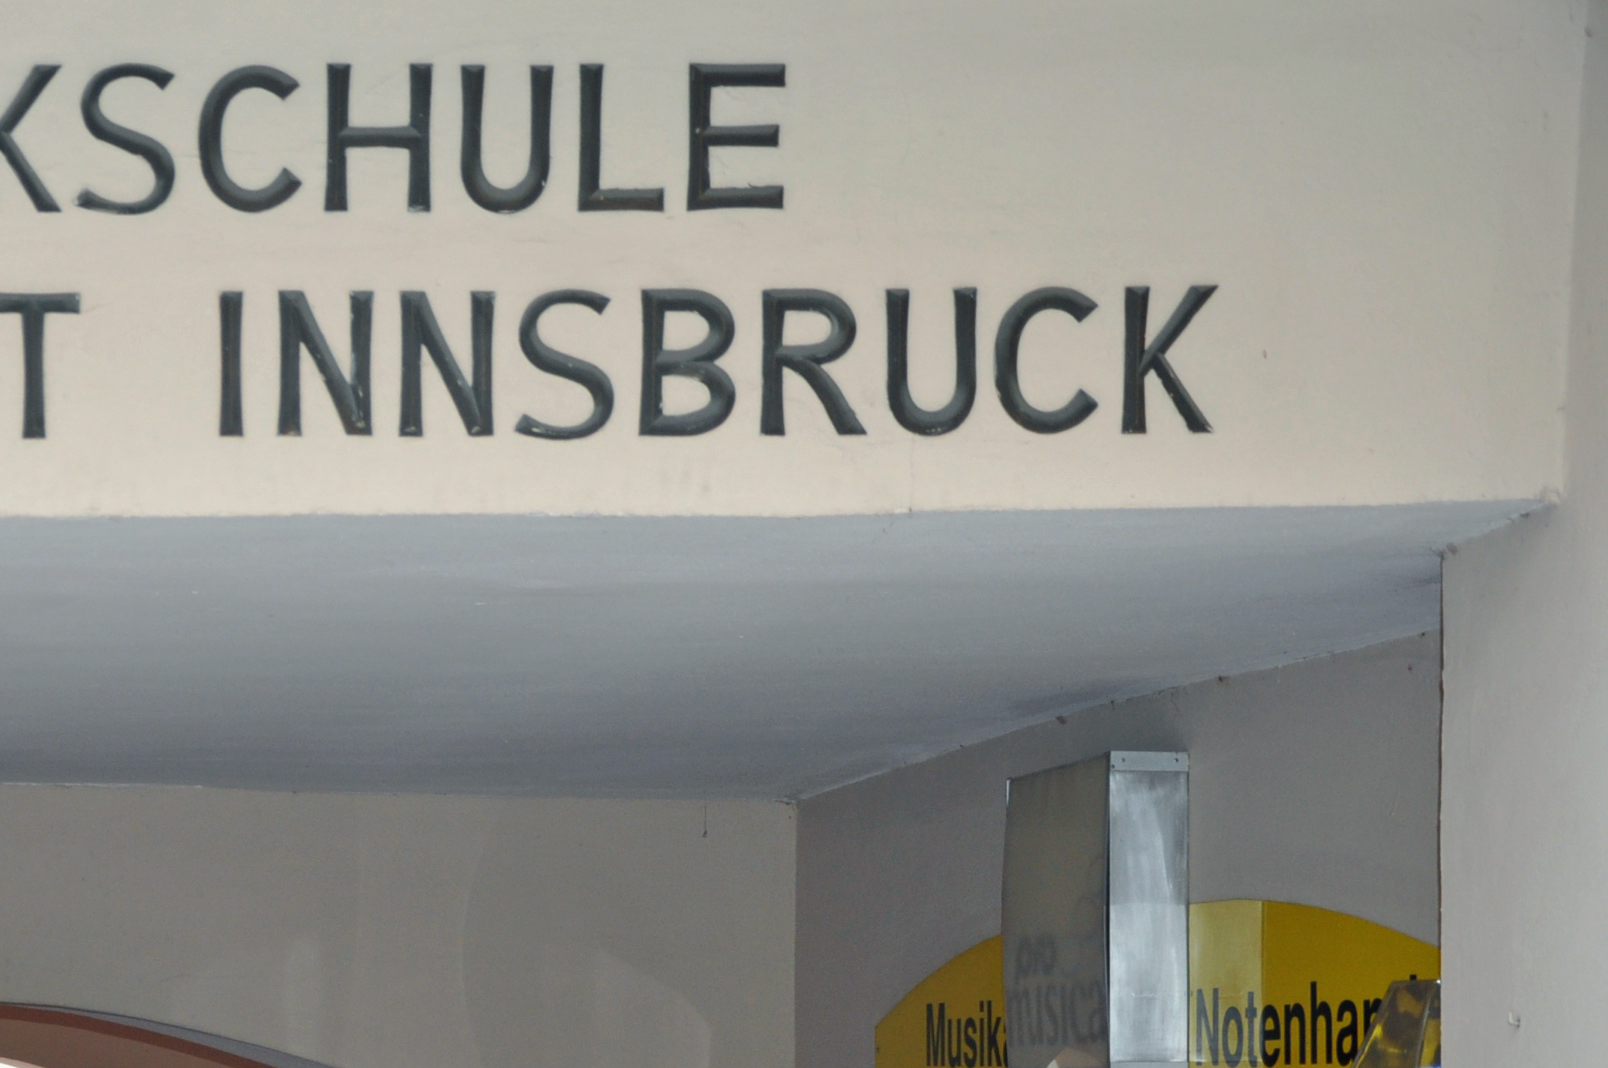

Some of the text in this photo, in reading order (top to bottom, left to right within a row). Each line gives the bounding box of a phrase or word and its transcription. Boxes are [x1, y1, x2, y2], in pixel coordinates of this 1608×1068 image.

[220, 285, 1218, 441] INNSBRUCK
[926, 975, 1416, 1068] Musik Notenha
